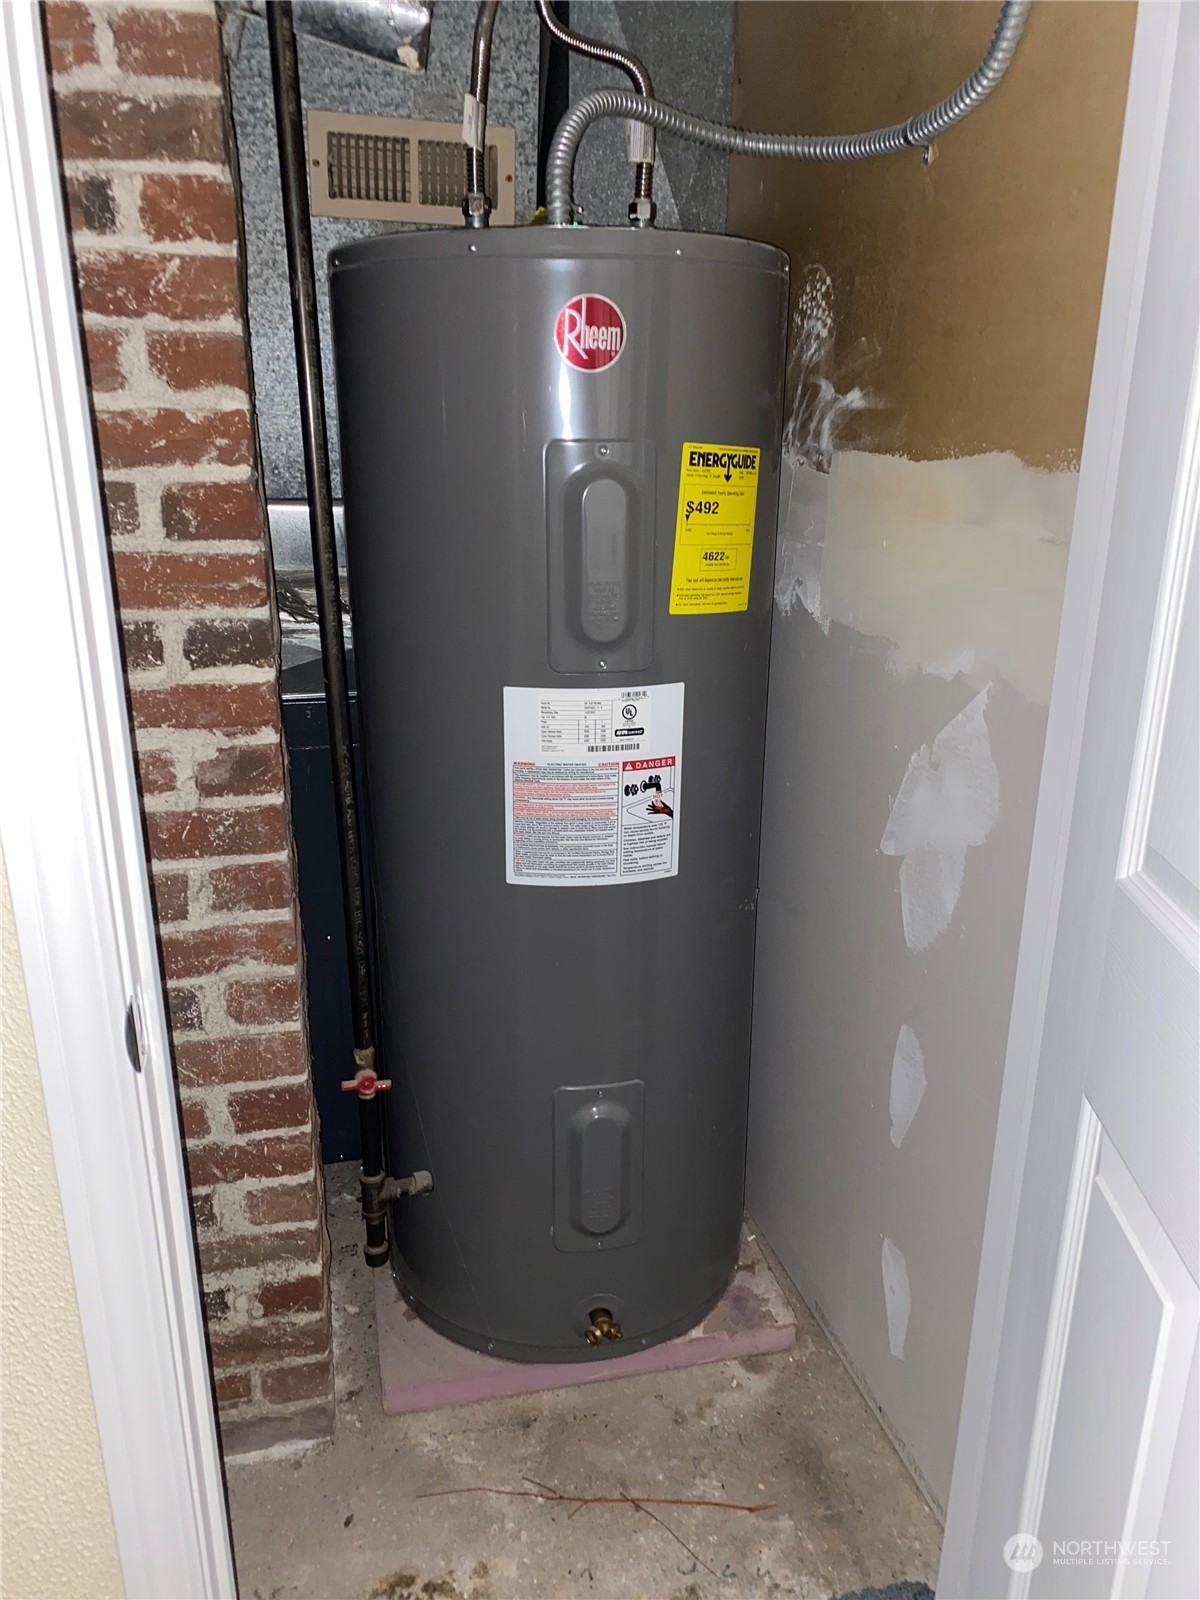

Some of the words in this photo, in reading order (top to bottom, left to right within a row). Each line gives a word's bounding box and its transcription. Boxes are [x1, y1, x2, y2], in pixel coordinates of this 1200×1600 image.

[563, 297, 621, 359] Rheem
[689, 451, 757, 470] ENERGYGUIDE
[686, 500, 719, 514] $492
[702, 551, 725, 561] 4622
[625, 707, 633, 717] UL
[635, 758, 673, 769] DANGER
